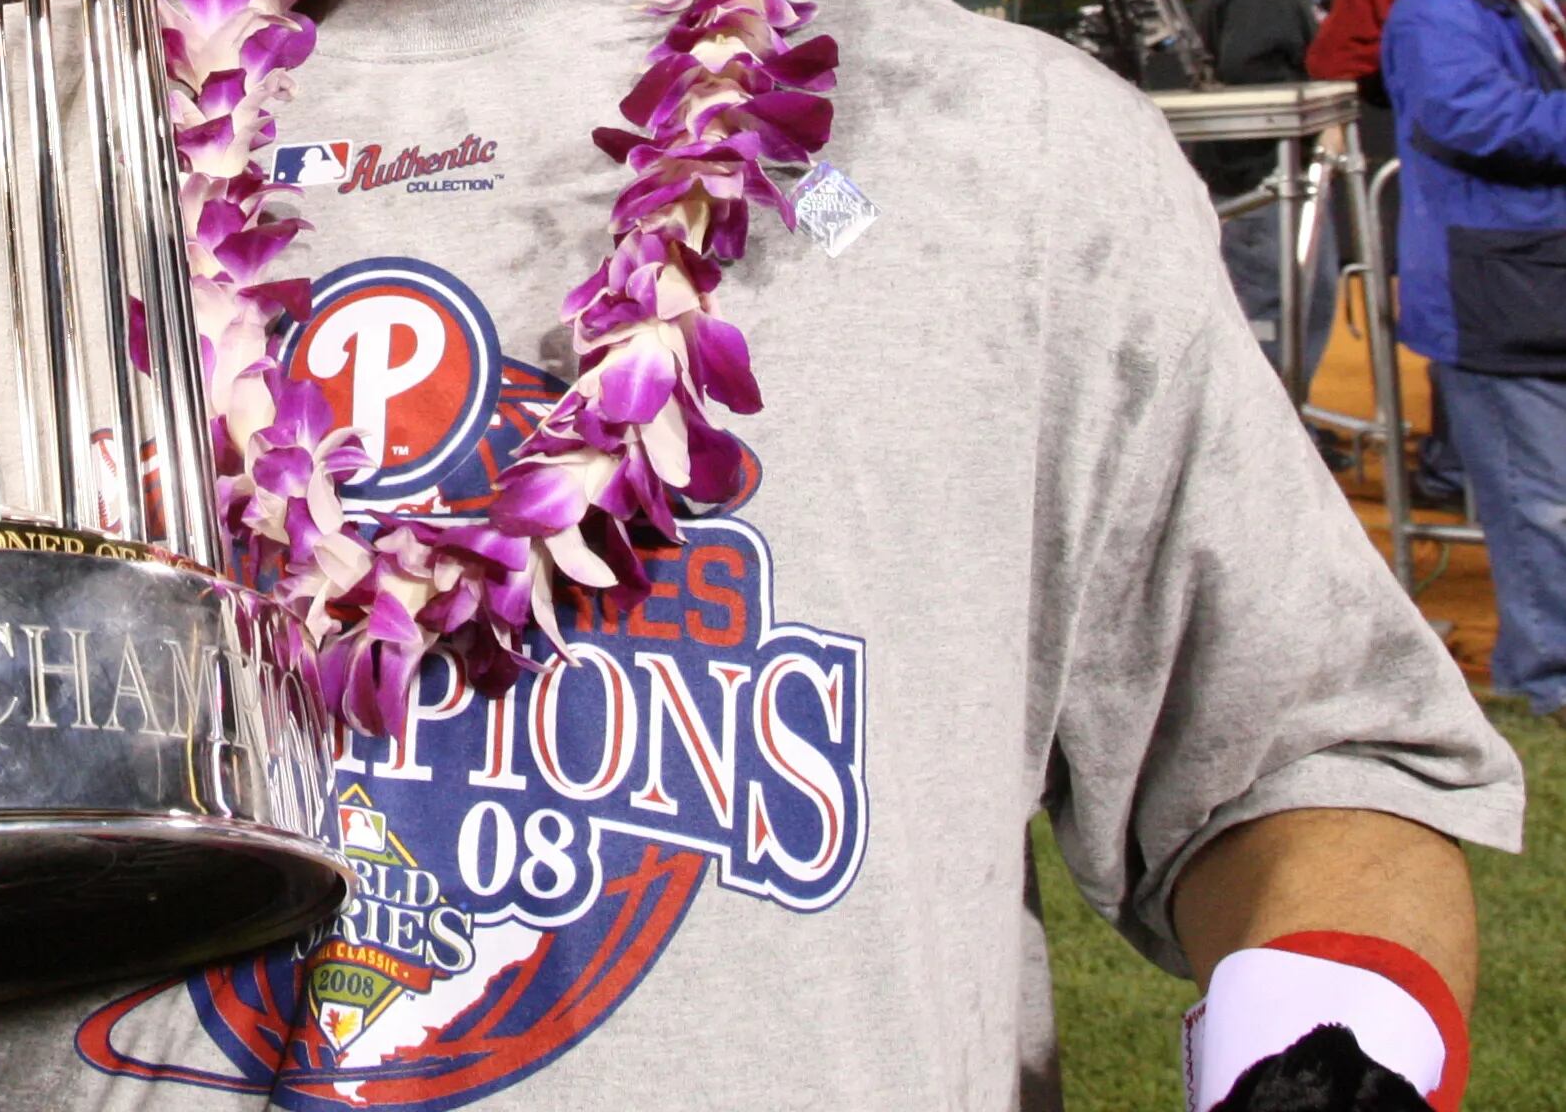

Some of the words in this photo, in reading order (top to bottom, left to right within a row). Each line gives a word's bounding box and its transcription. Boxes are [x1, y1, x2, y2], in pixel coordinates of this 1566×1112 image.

[338, 133, 498, 194] Authentic
[406, 179, 494, 193] COLLECTION
[307, 295, 446, 485] P
[458, 800, 577, 900] 08
[352, 858, 440, 908] RLD
[318, 968, 375, 999] 2008
[336, 941, 400, 978] CLASSIC
